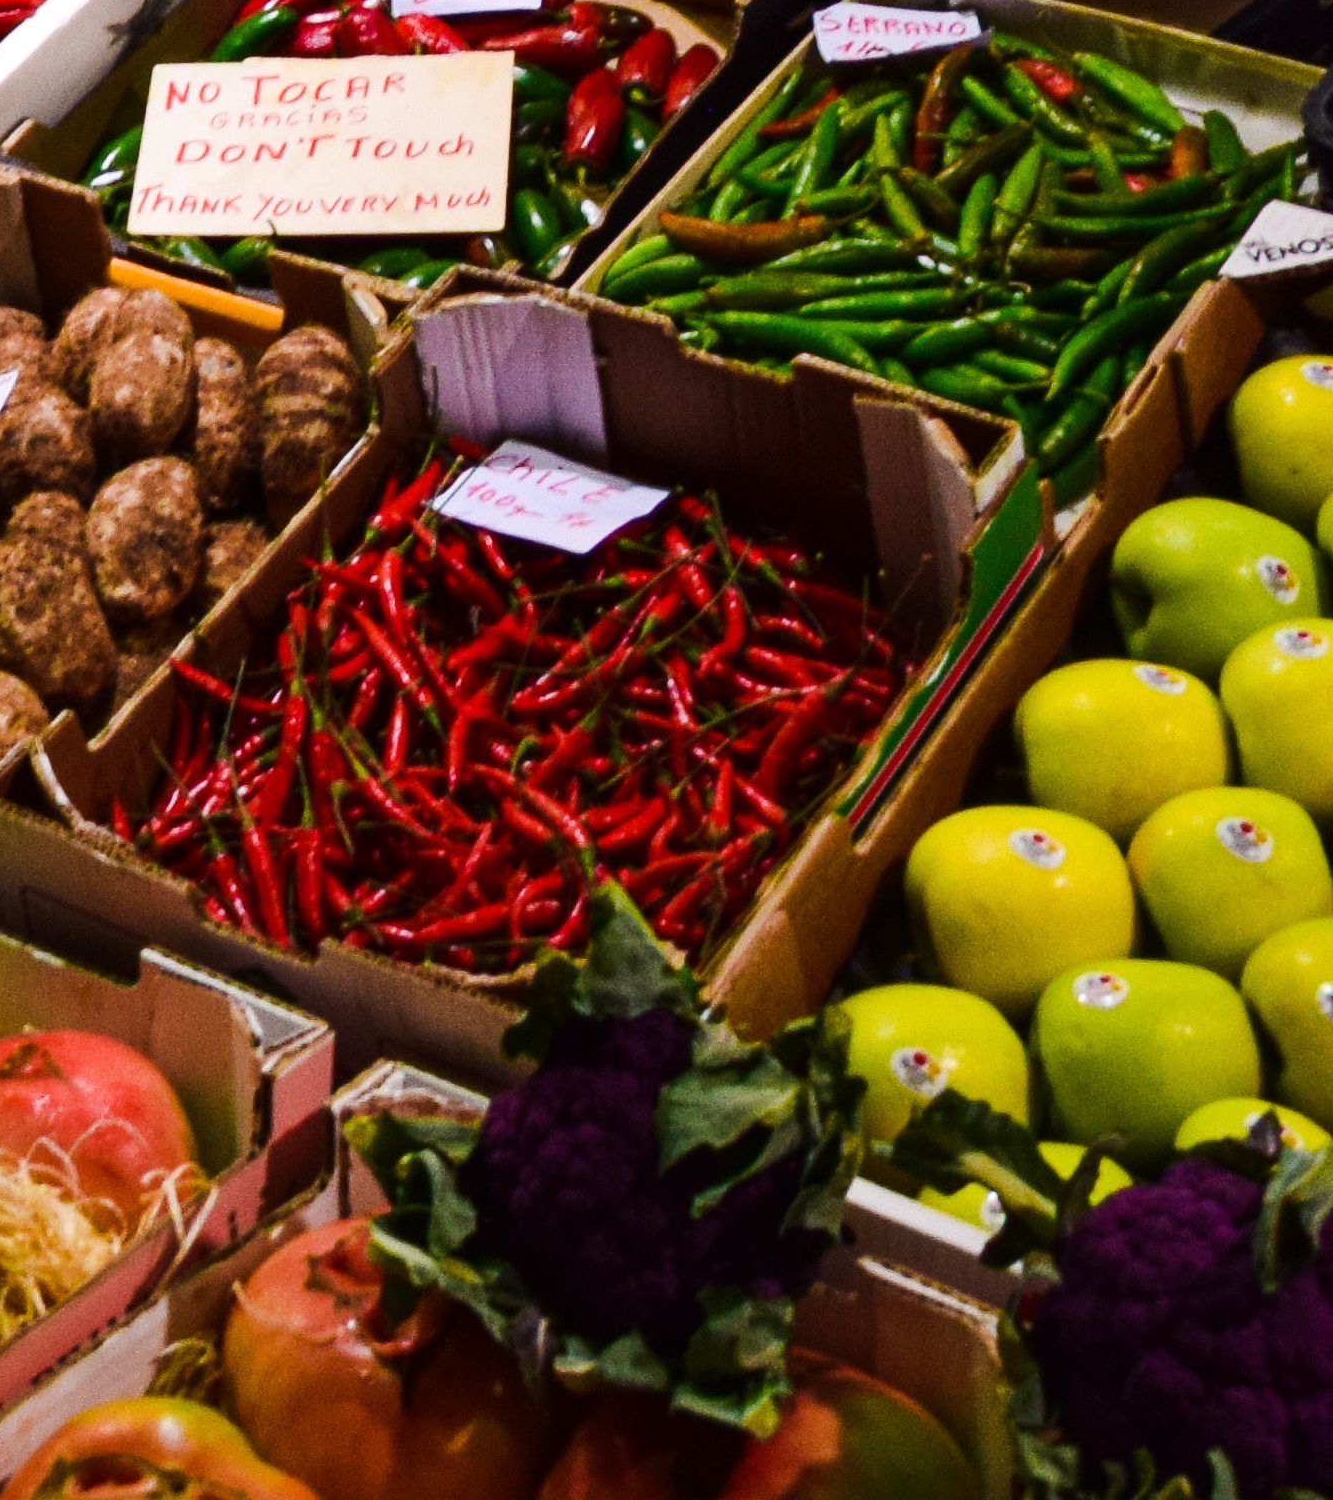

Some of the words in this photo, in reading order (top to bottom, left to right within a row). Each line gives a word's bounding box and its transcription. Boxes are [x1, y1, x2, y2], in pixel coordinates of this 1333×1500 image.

[820, 13, 967, 37] SERRANO
[164, 80, 221, 111] NO
[242, 72, 406, 106] TOCAR
[175, 133, 335, 165] DON'T
